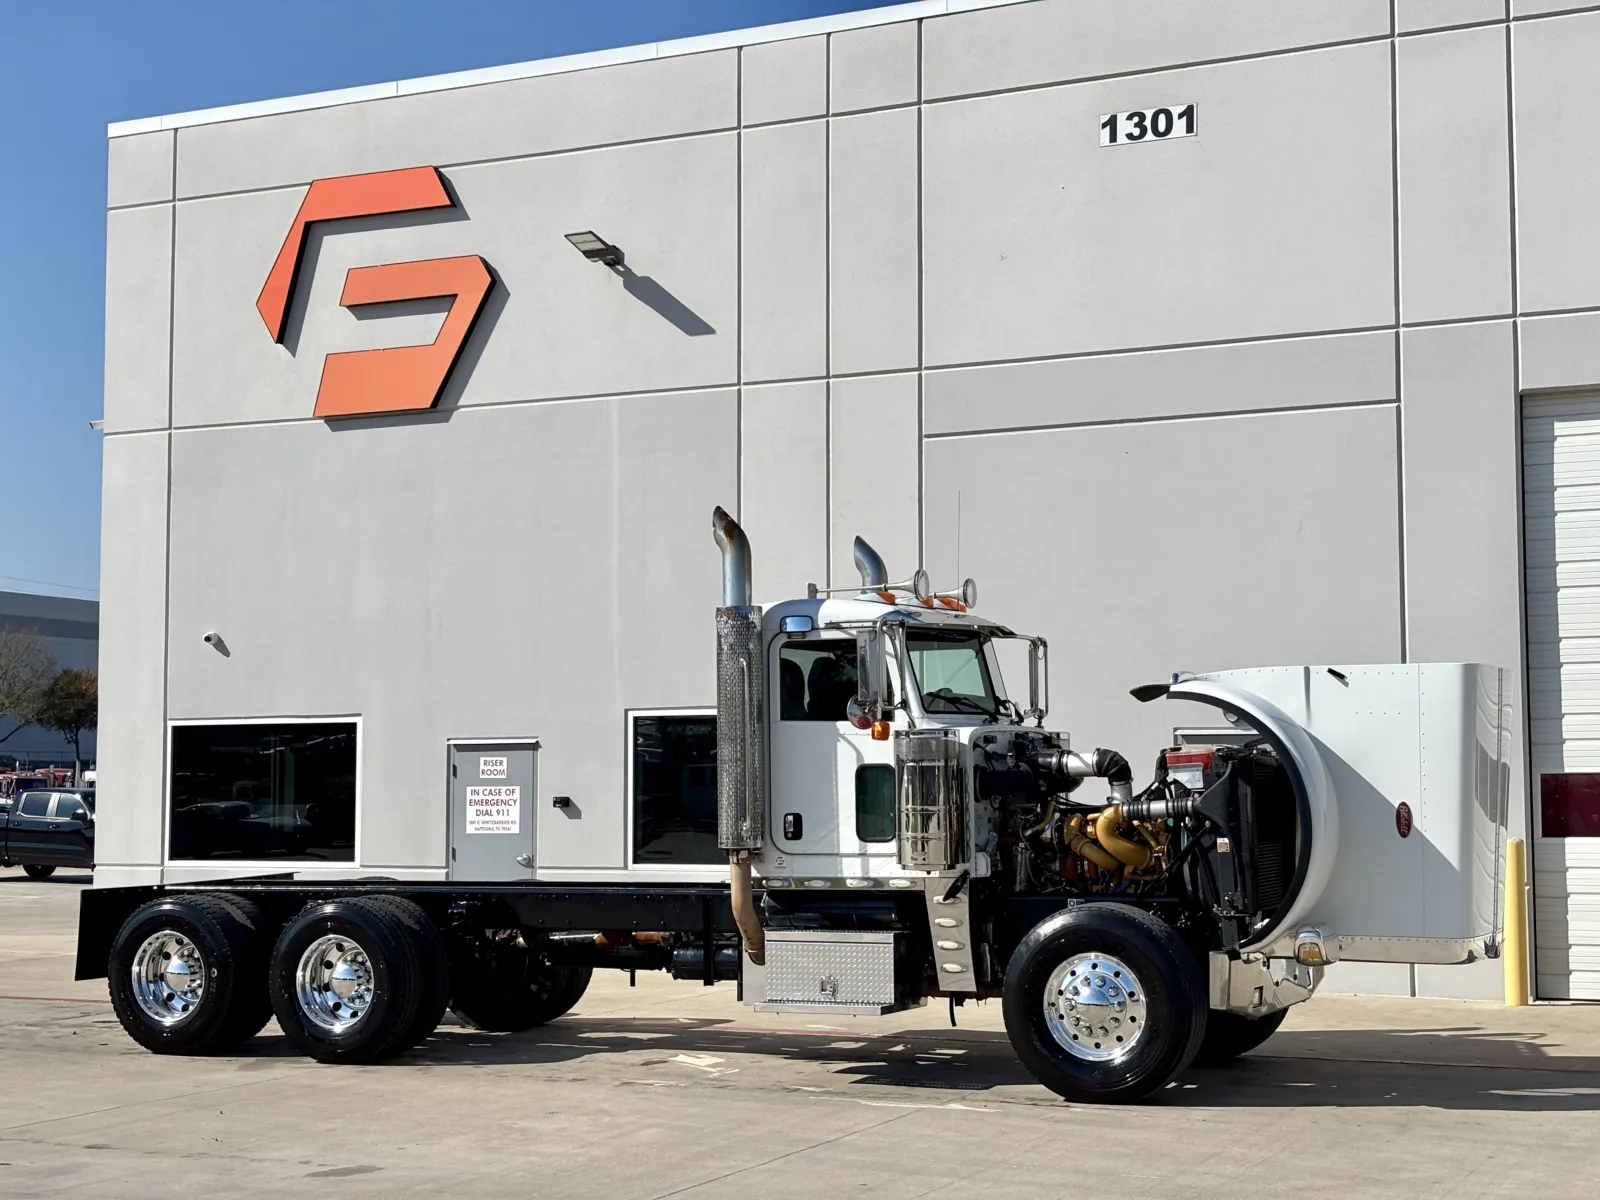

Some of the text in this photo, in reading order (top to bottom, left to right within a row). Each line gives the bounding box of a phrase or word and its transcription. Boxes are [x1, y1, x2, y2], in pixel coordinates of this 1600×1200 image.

[1101, 104, 1194, 143] 1301
[483, 759, 504, 767] RISER
[482, 788, 502, 796] CASE
[504, 788, 516, 796] OF
[469, 799, 517, 807] EMERGENCY
